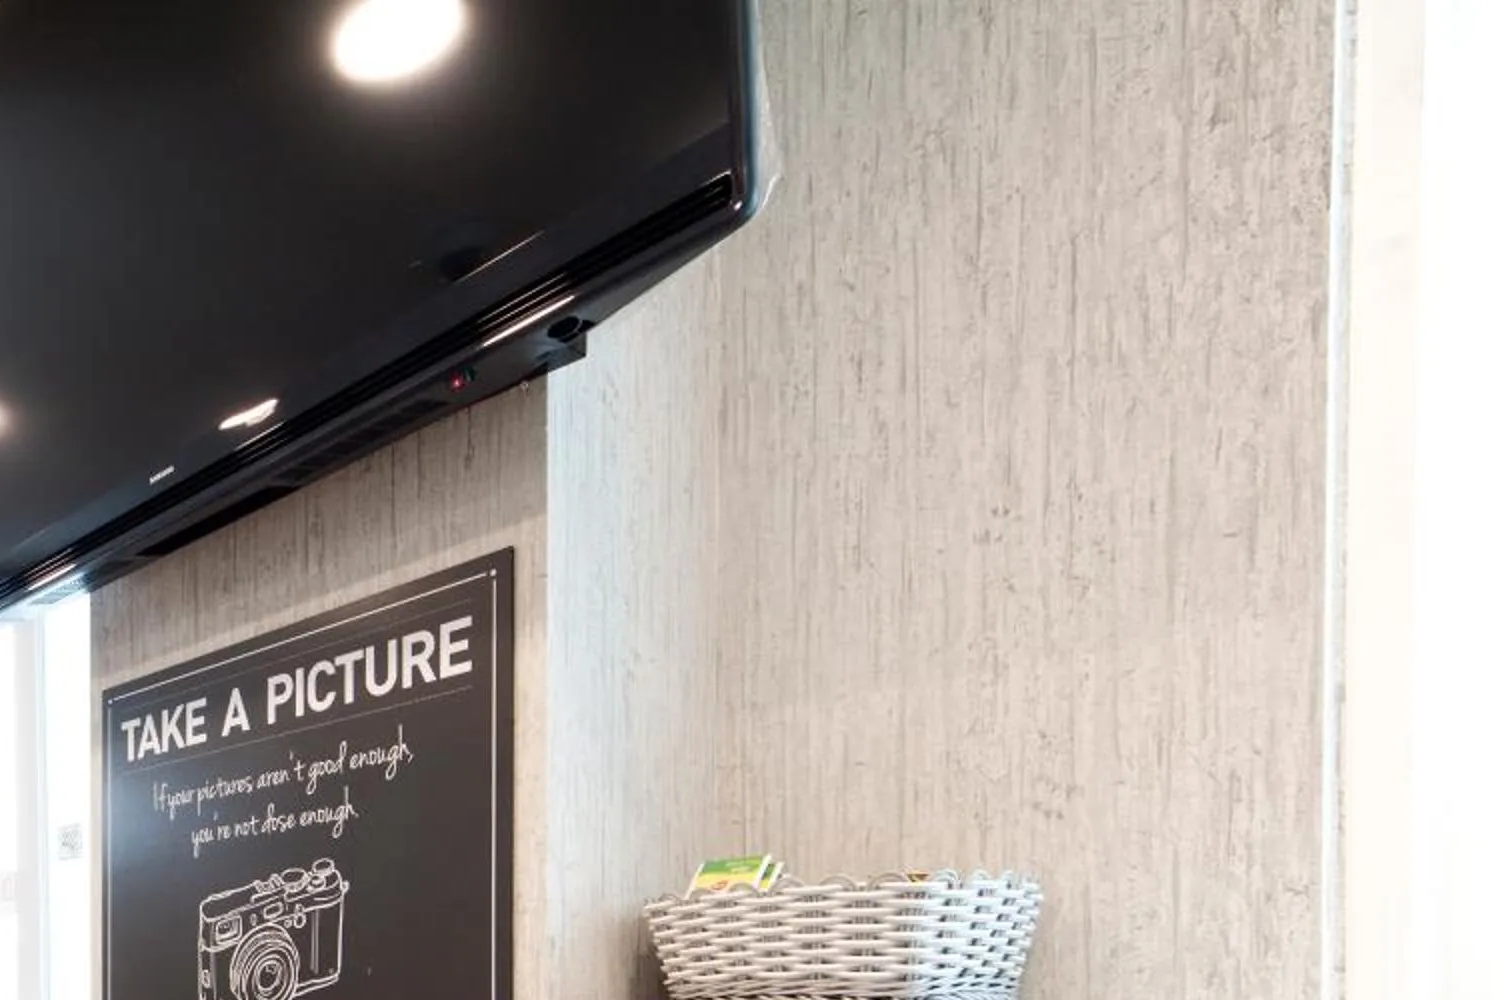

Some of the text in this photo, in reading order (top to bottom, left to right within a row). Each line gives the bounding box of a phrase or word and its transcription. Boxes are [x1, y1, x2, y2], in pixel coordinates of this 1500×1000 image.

[121, 615, 473, 762] TAKE A PICTURE
[153, 723, 414, 821] If your pictures aren't good enough,
[191, 811, 231, 859] you're
[234, 815, 260, 836] not
[300, 785, 359, 839] enough.
